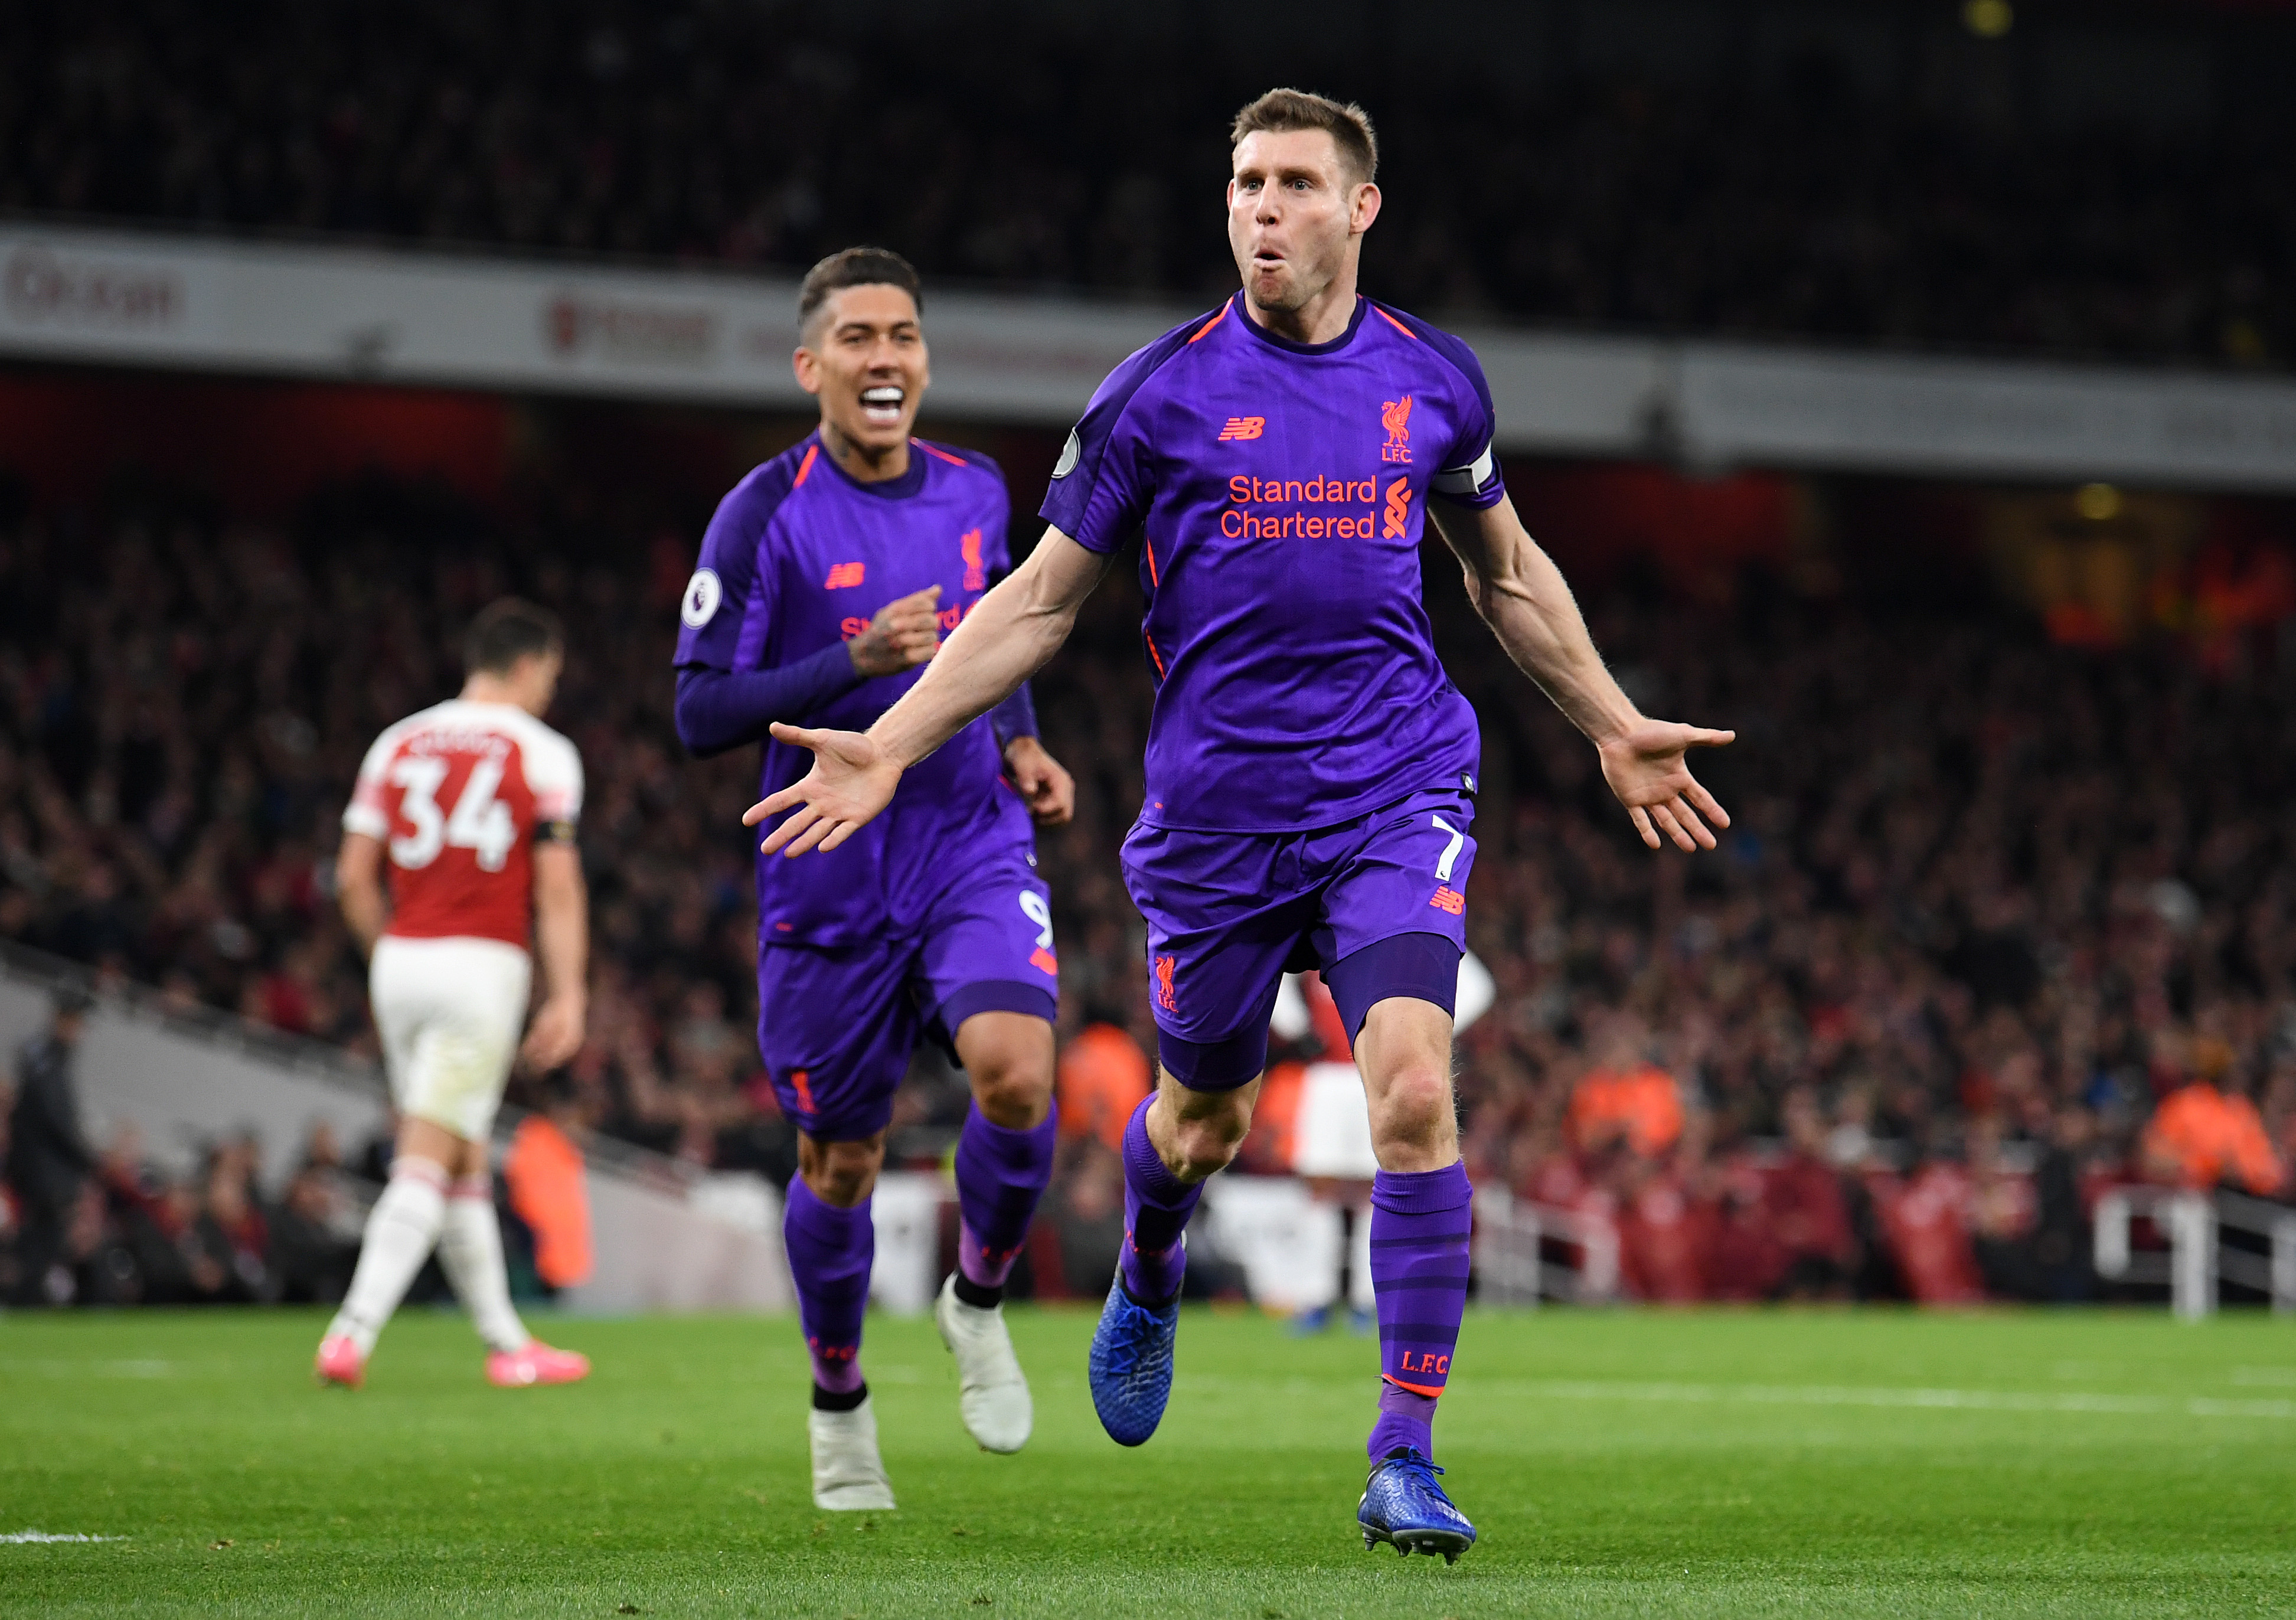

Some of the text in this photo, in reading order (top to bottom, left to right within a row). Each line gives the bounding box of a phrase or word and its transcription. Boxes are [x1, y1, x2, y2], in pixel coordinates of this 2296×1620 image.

[1229, 475, 1376, 502] Standard
[1220, 510, 1375, 538] Chartered
[390, 756, 517, 873] 34
[1432, 814, 1464, 881] 7
[1018, 889, 1054, 949] 9
